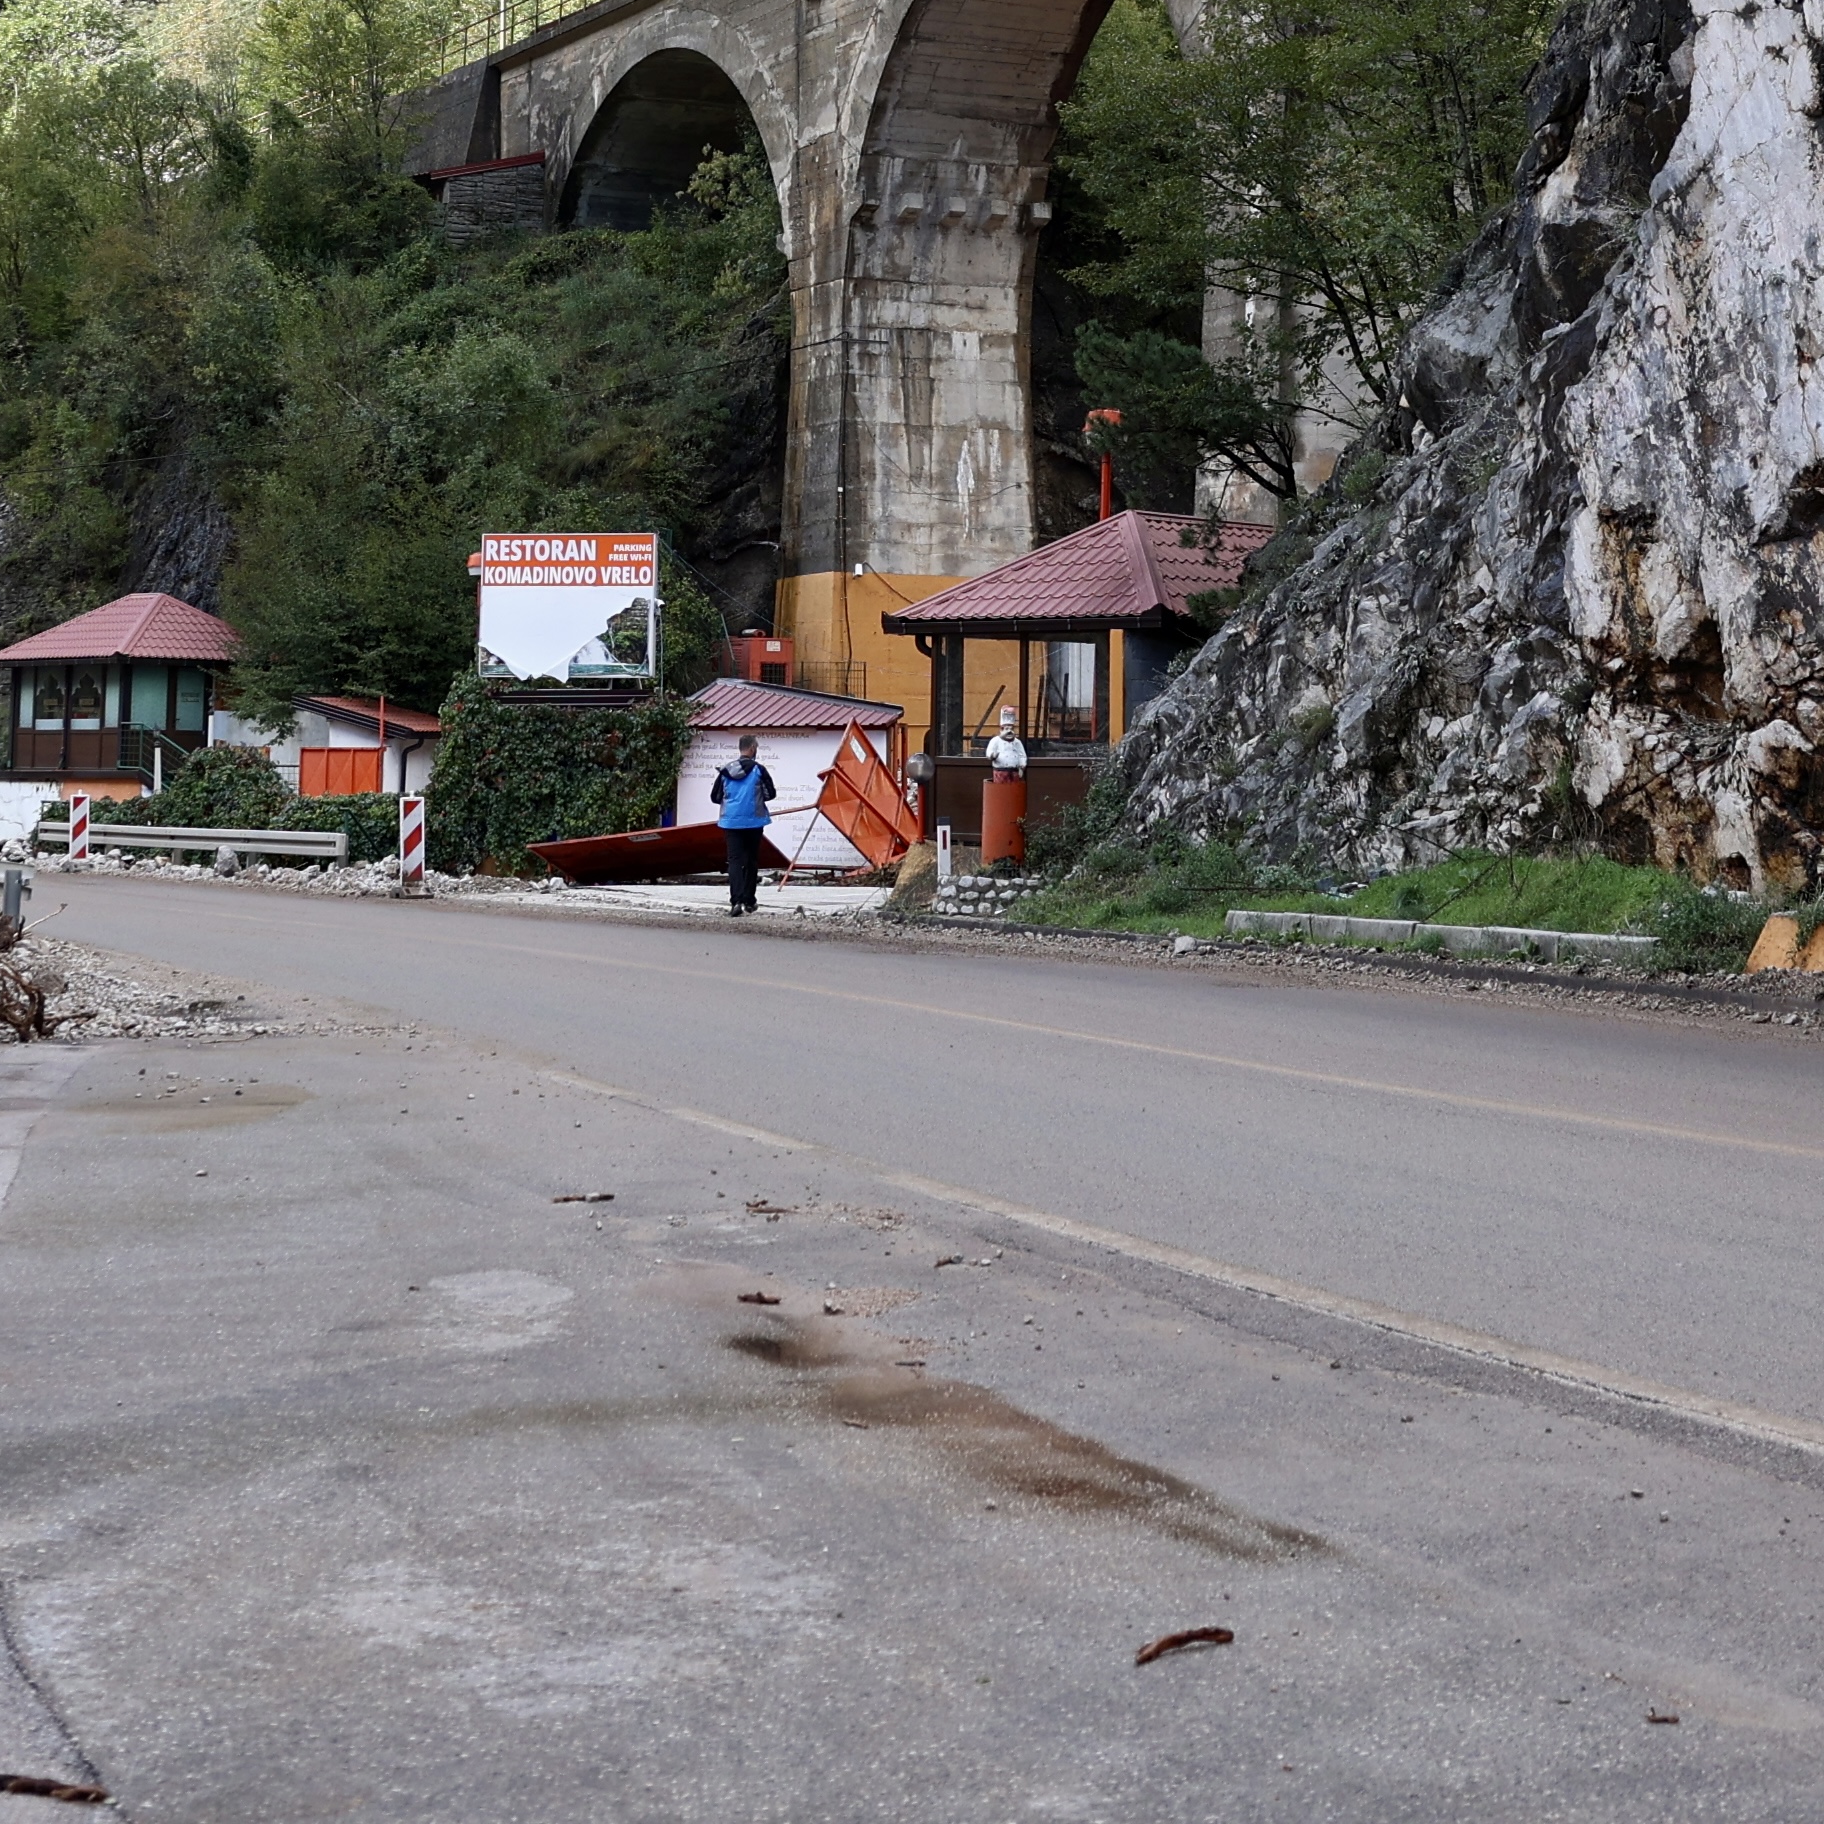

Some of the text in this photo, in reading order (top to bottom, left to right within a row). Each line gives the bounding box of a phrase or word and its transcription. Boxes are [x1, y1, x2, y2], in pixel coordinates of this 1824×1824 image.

[485, 539, 597, 562] RESTORAN
[613, 543, 652, 552] PARKING
[608, 553, 652, 562] FREE WI-FI
[484, 566, 652, 585] KOMADINOVO VRELO
